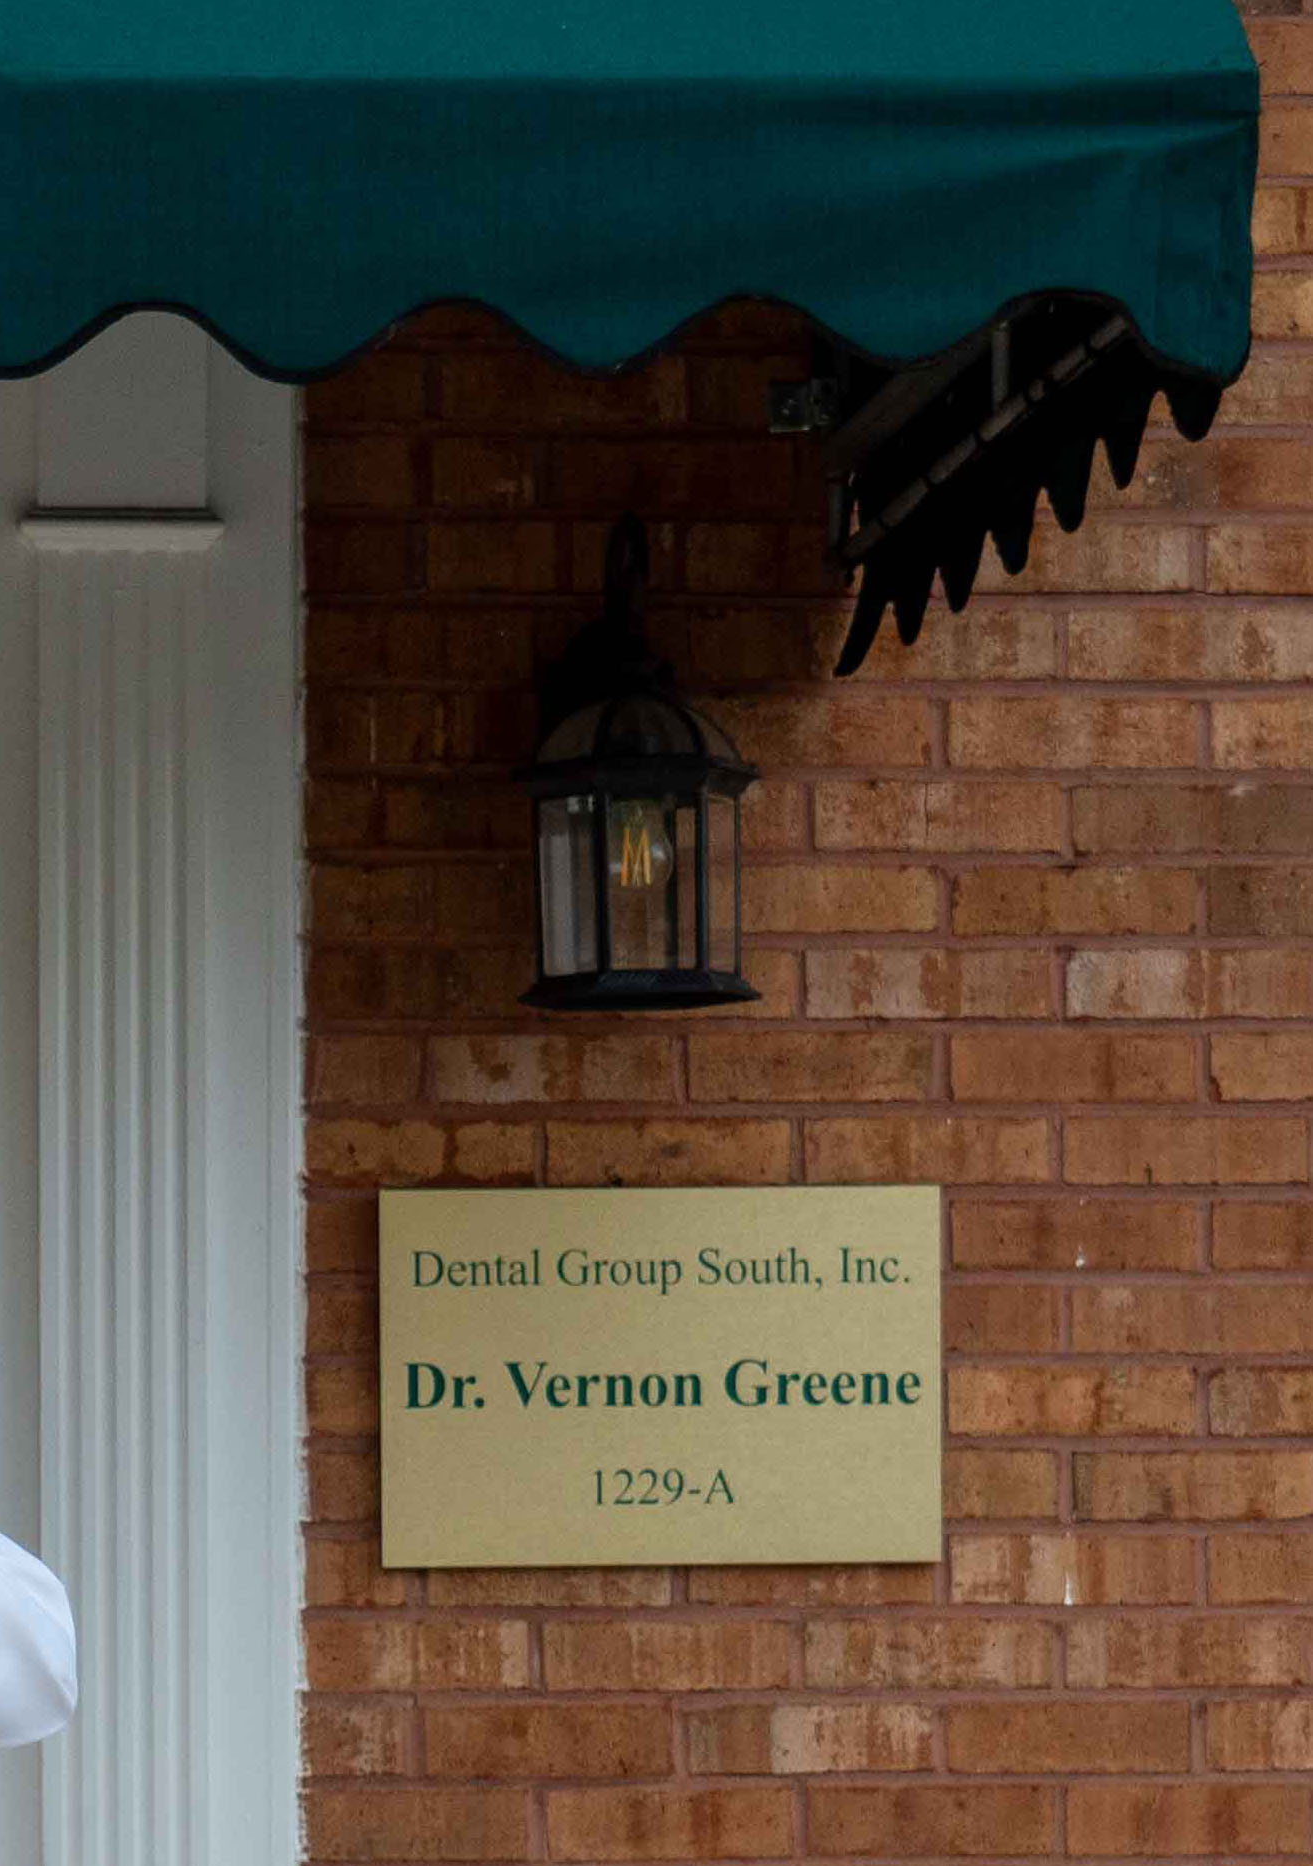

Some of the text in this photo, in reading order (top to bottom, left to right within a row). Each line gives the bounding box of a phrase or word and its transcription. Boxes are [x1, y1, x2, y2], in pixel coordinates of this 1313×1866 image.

[411, 1246, 910, 1295] Dental Group South, Inc.
[405, 1358, 922, 1410] Dr. Vernon Greene
[589, 1468, 736, 1506] 1229-A
